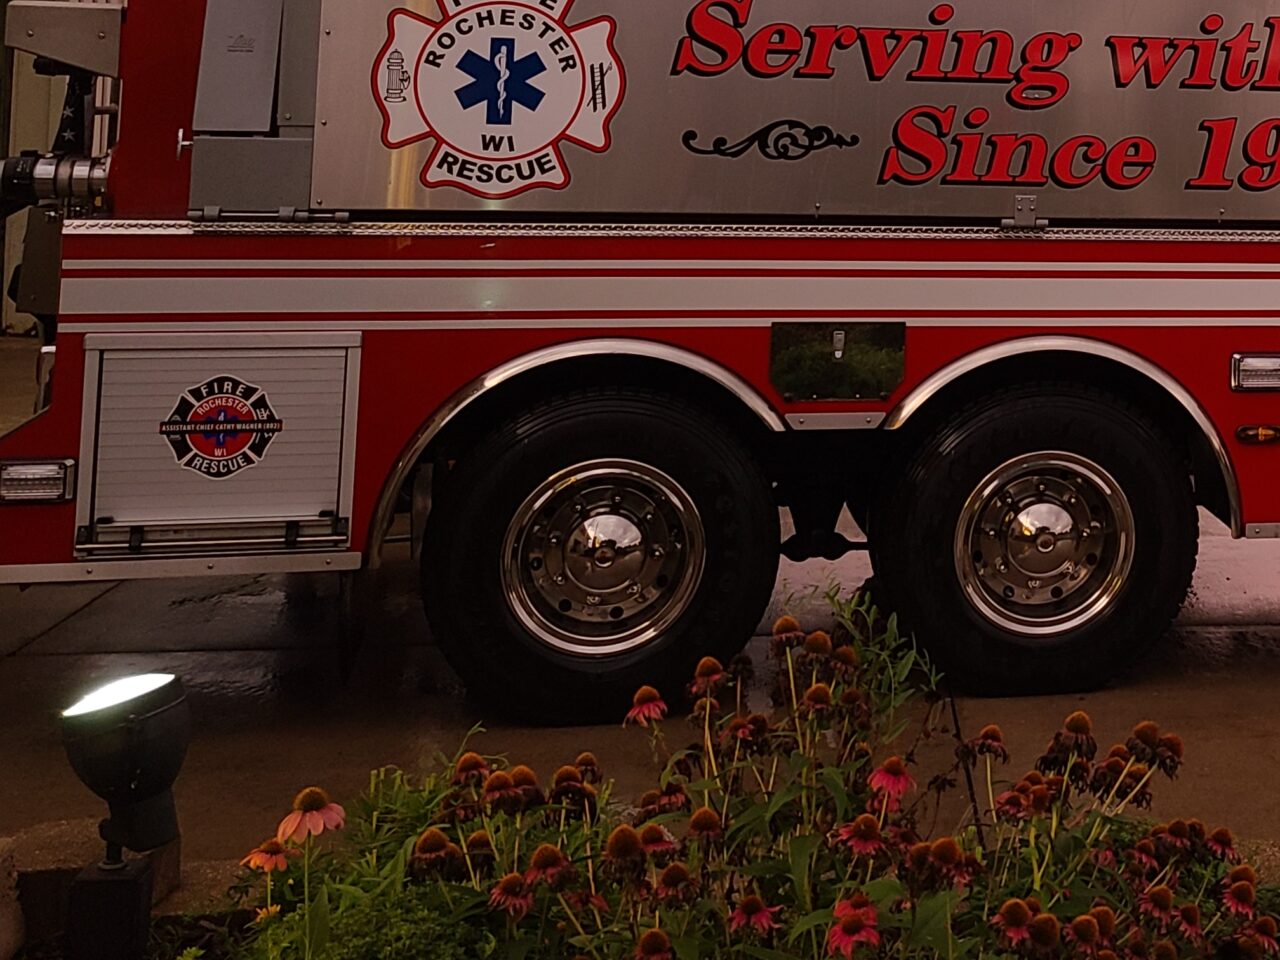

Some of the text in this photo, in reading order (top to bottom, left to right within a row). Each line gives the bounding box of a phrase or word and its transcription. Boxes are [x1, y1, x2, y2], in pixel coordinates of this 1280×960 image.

[423, 8, 578, 73] ROCHESTER
[480, 134, 515, 152] WI
[876, 105, 1157, 190] Since
[436, 150, 556, 183] RESCUE
[200, 381, 247, 397] FIRE
[196, 397, 250, 416] ROCHESTER
[161, 423, 195, 432] ASSISTANT
[196, 423, 214, 431] CHIEF
[214, 448, 227, 457] WI
[191, 455, 248, 473] RESCUE
